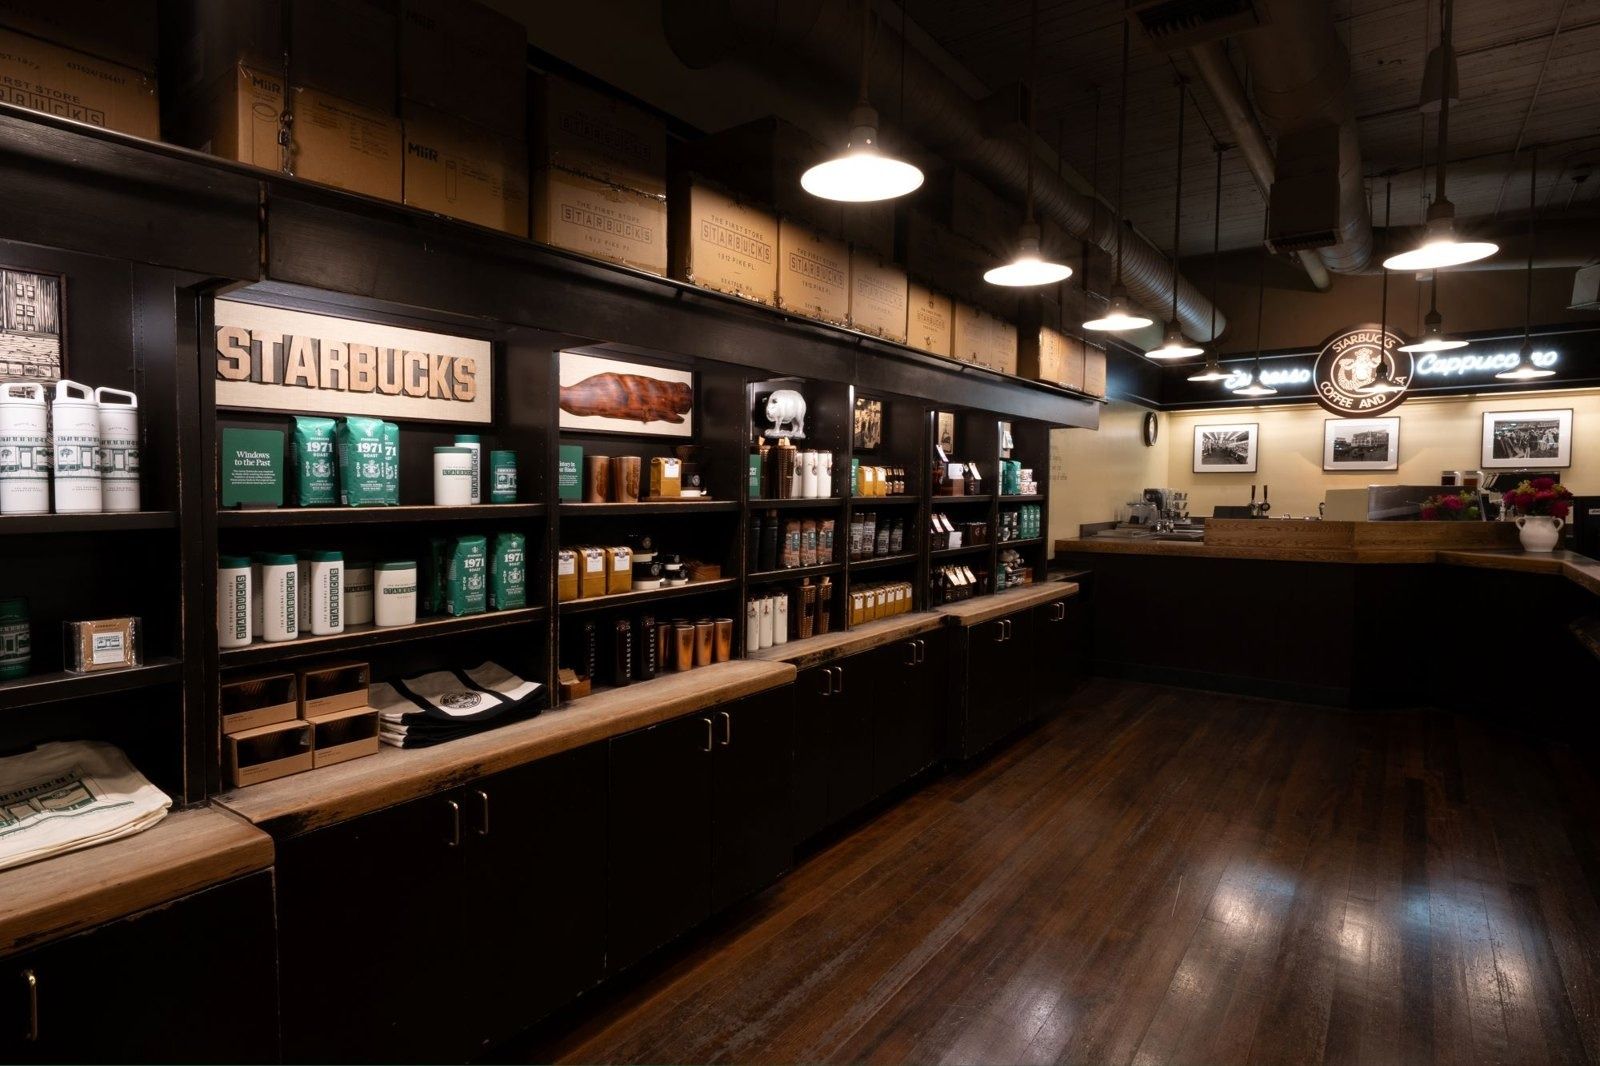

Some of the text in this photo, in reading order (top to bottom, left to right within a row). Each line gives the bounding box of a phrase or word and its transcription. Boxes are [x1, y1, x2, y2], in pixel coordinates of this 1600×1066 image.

[35, 84, 81, 104] STORE
[253, 76, 281, 94] MiiR
[408, 142, 438, 163] MiiR
[563, 208, 650, 241] STARBUCKS
[712, 215, 764, 241] THE FIRST STORE
[703, 225, 771, 261] STARBUCKS
[791, 257, 843, 286] STARBUCKS
[215, 325, 477, 402] STARBUCKS
[1320, 381, 1386, 409] COFFEE AND
[236, 451, 270, 459] Windows
[306, 441, 333, 453] 1971
[356, 442, 382, 454] 1971
[385, 446, 396, 457] 71
[256, 459, 271, 467] Past
[464, 558, 485, 569] 1971
[504, 553, 524, 563] 1971
[236, 575, 246, 639] STARBUCKS
[287, 571, 295, 633] STARBUCKS
[330, 568, 339, 627] STARBUCKS
